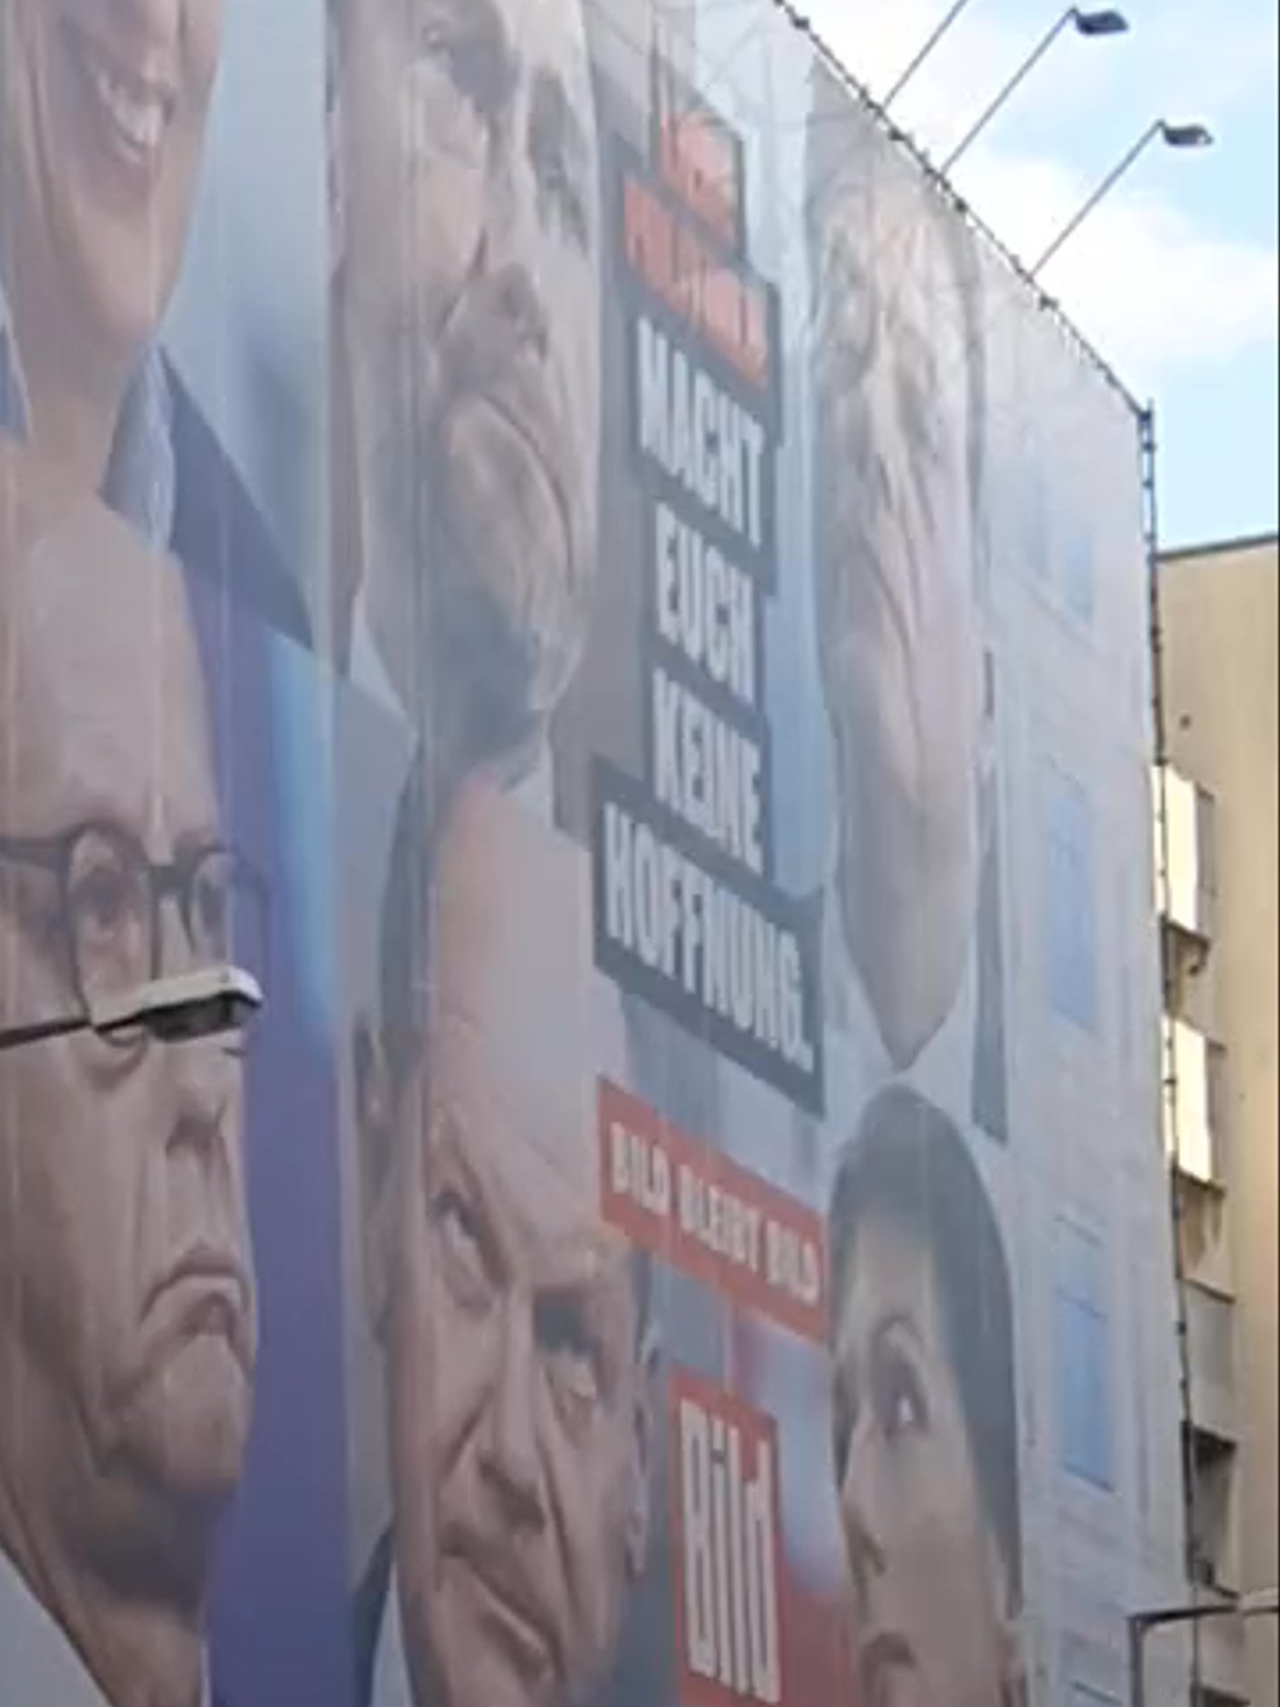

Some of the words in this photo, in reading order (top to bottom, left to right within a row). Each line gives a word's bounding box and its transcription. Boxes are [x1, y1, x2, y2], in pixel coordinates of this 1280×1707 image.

[639, 316, 763, 549] MACHT
[656, 502, 754, 703] EUCH
[653, 666, 763, 874] KEINE
[604, 802, 814, 1073] HOFFNUNG.
